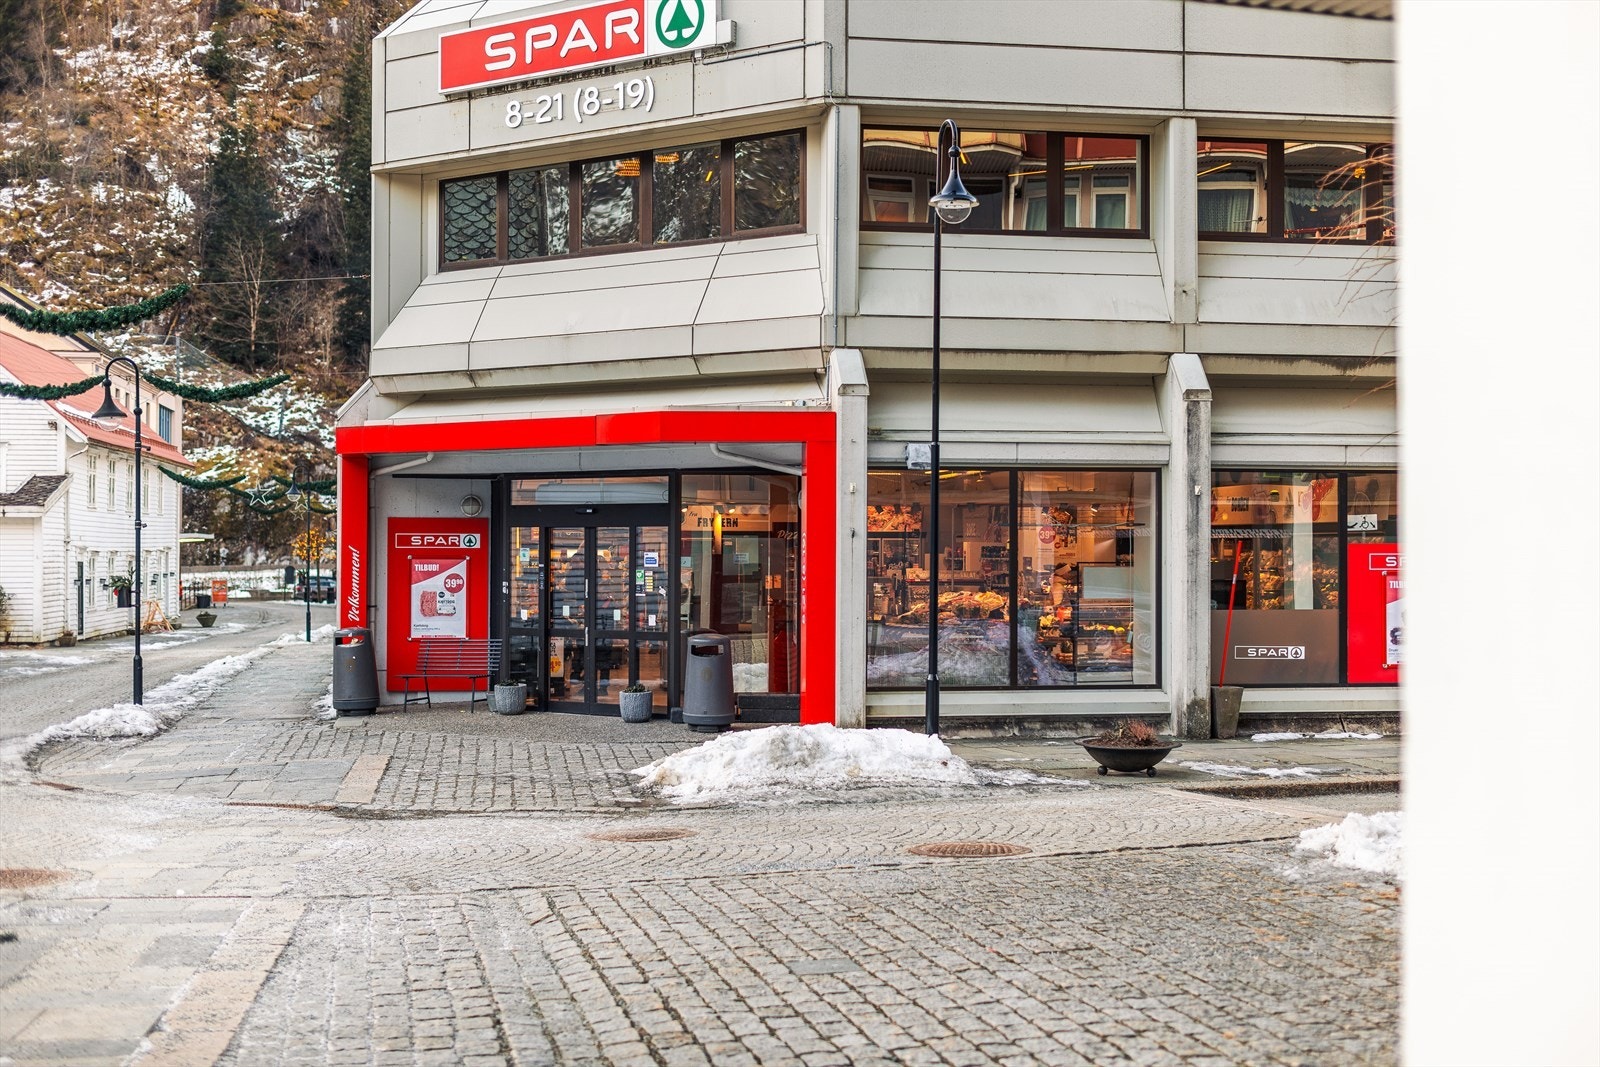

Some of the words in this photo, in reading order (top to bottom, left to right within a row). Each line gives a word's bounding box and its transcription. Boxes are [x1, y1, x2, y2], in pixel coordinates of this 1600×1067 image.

[484, 7, 640, 72] SPAR
[505, 92, 564, 128] 8-21
[573, 75, 655, 123] (8-19)
[410, 536, 460, 545] SPAR
[414, 563, 440, 572] TILBUD!
[347, 545, 360, 622] Velkommen!
[1247, 648, 1288, 657] SPAR
